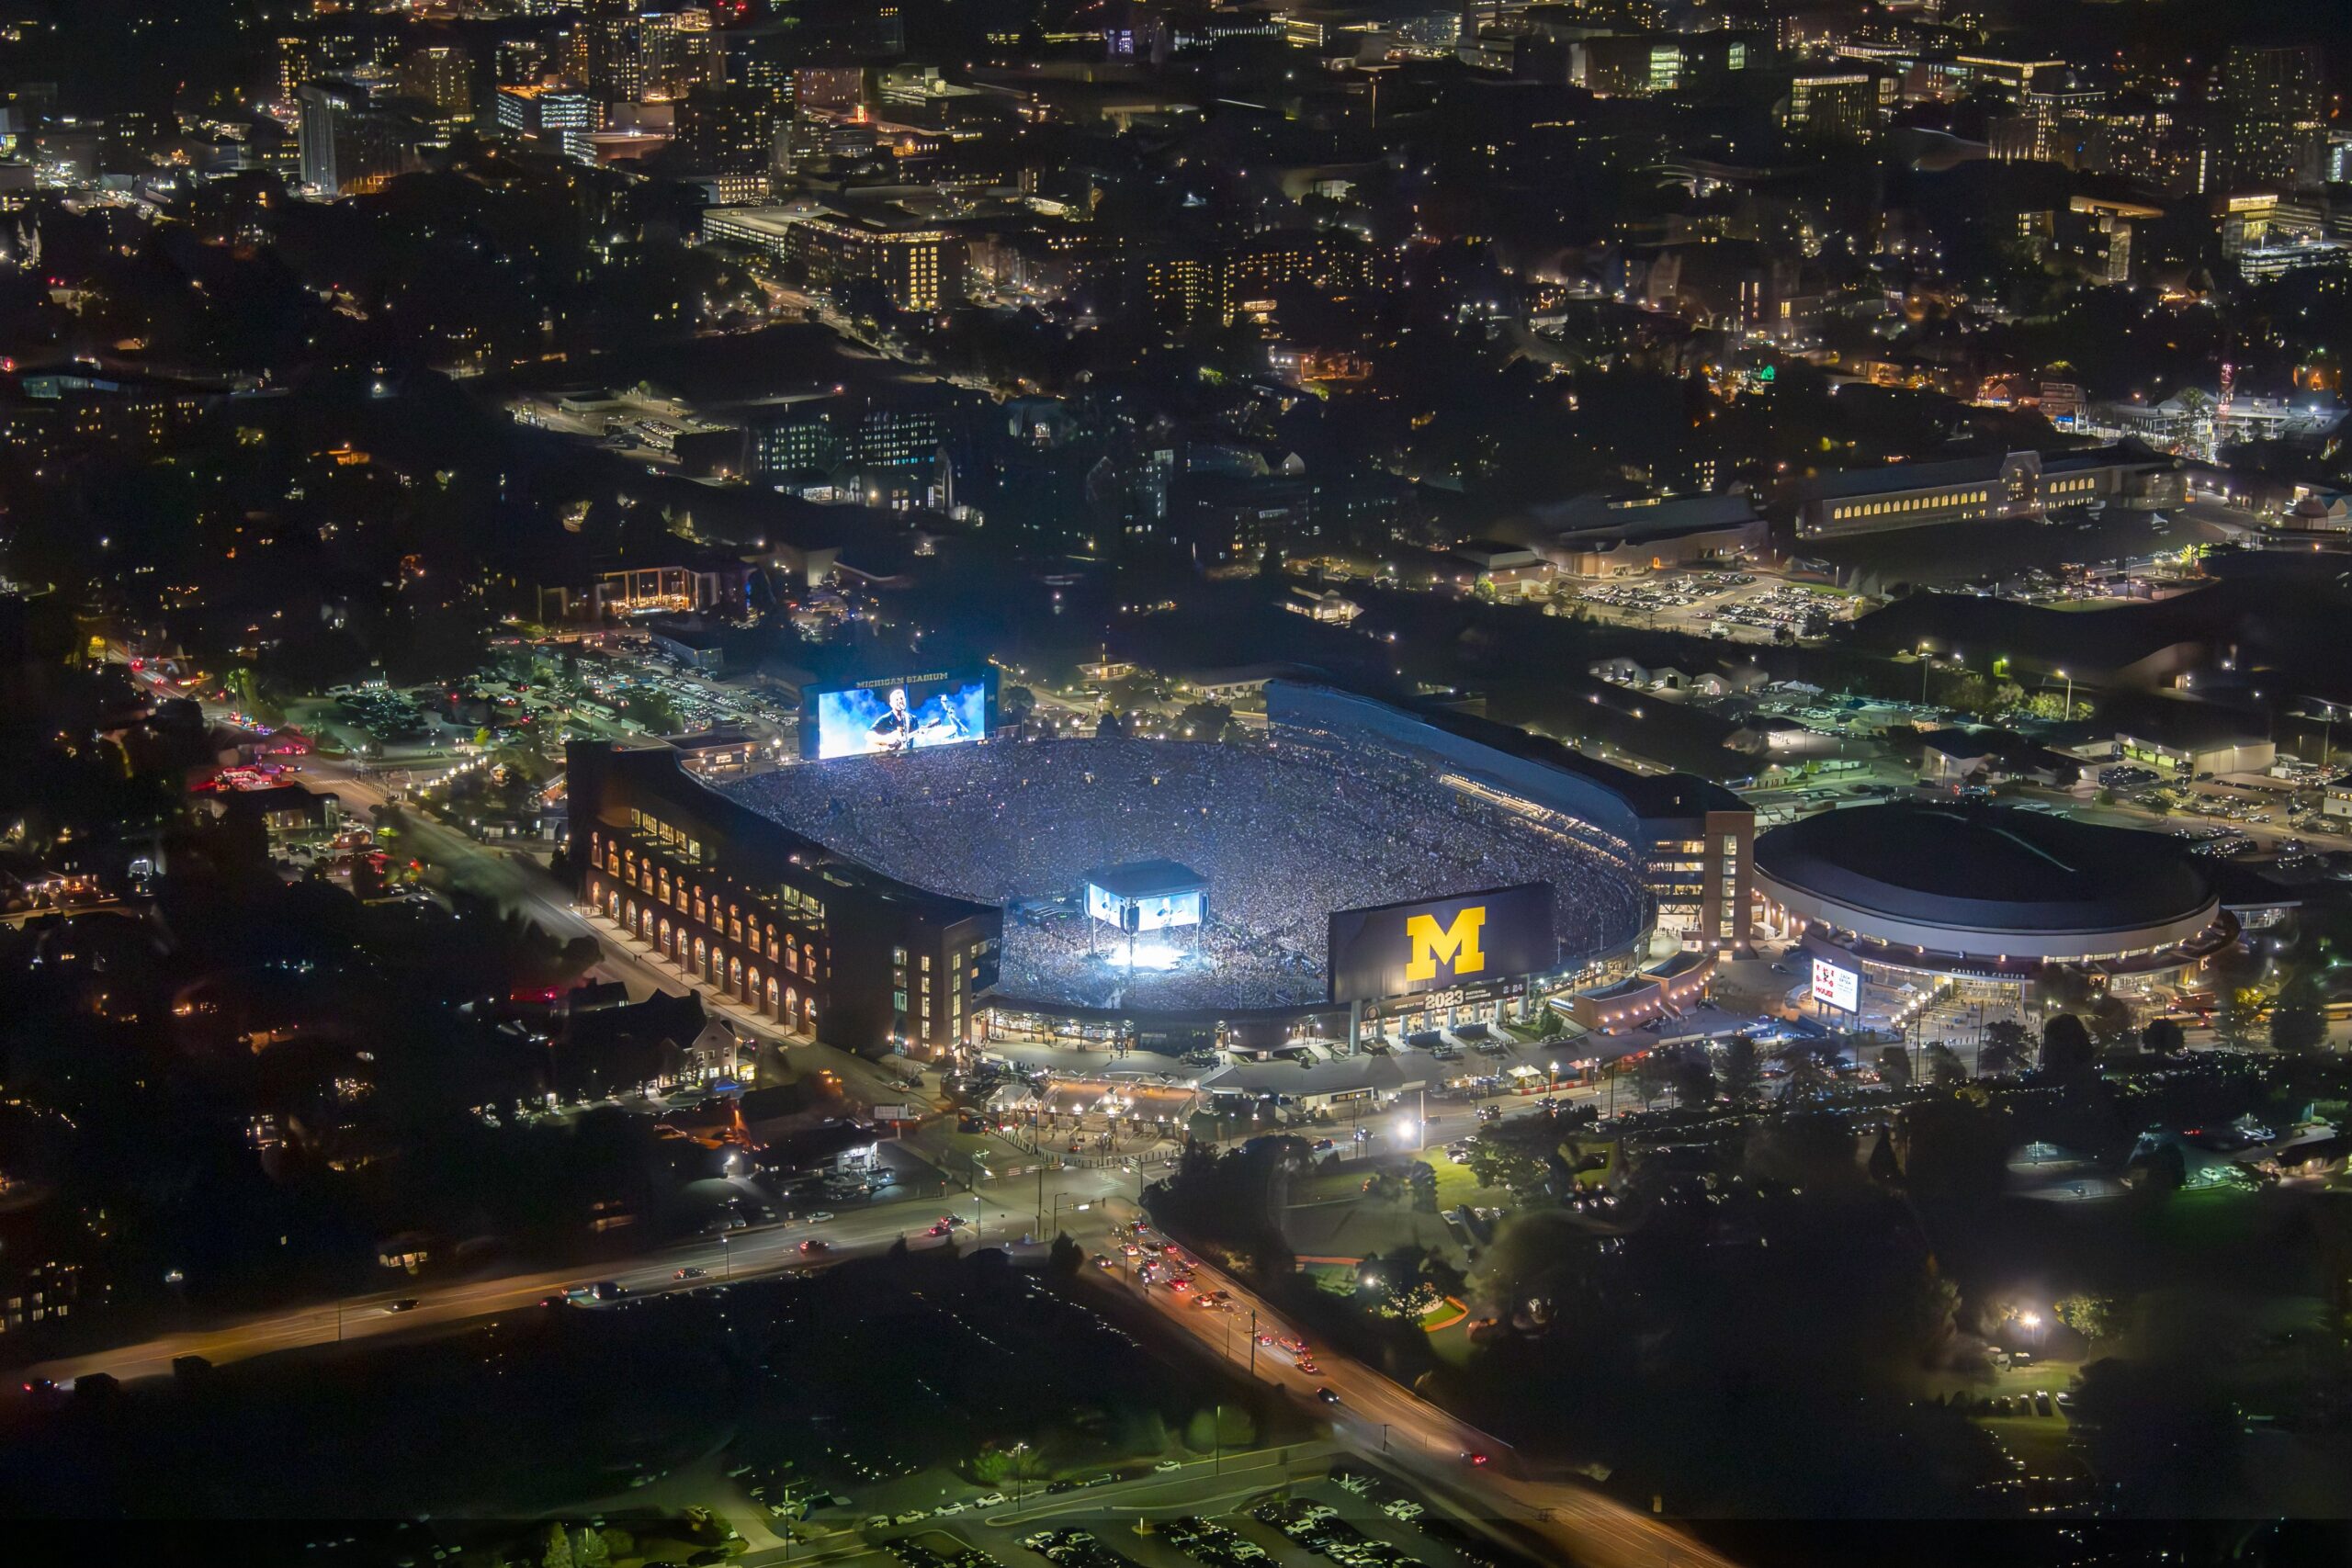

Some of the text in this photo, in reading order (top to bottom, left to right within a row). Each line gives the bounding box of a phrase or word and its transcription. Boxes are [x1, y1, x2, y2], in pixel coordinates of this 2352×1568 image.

[856, 672, 948, 688] MICHIGAN STADIUM
[1406, 906, 1486, 982] M
[1425, 989, 1464, 1010] 2023
